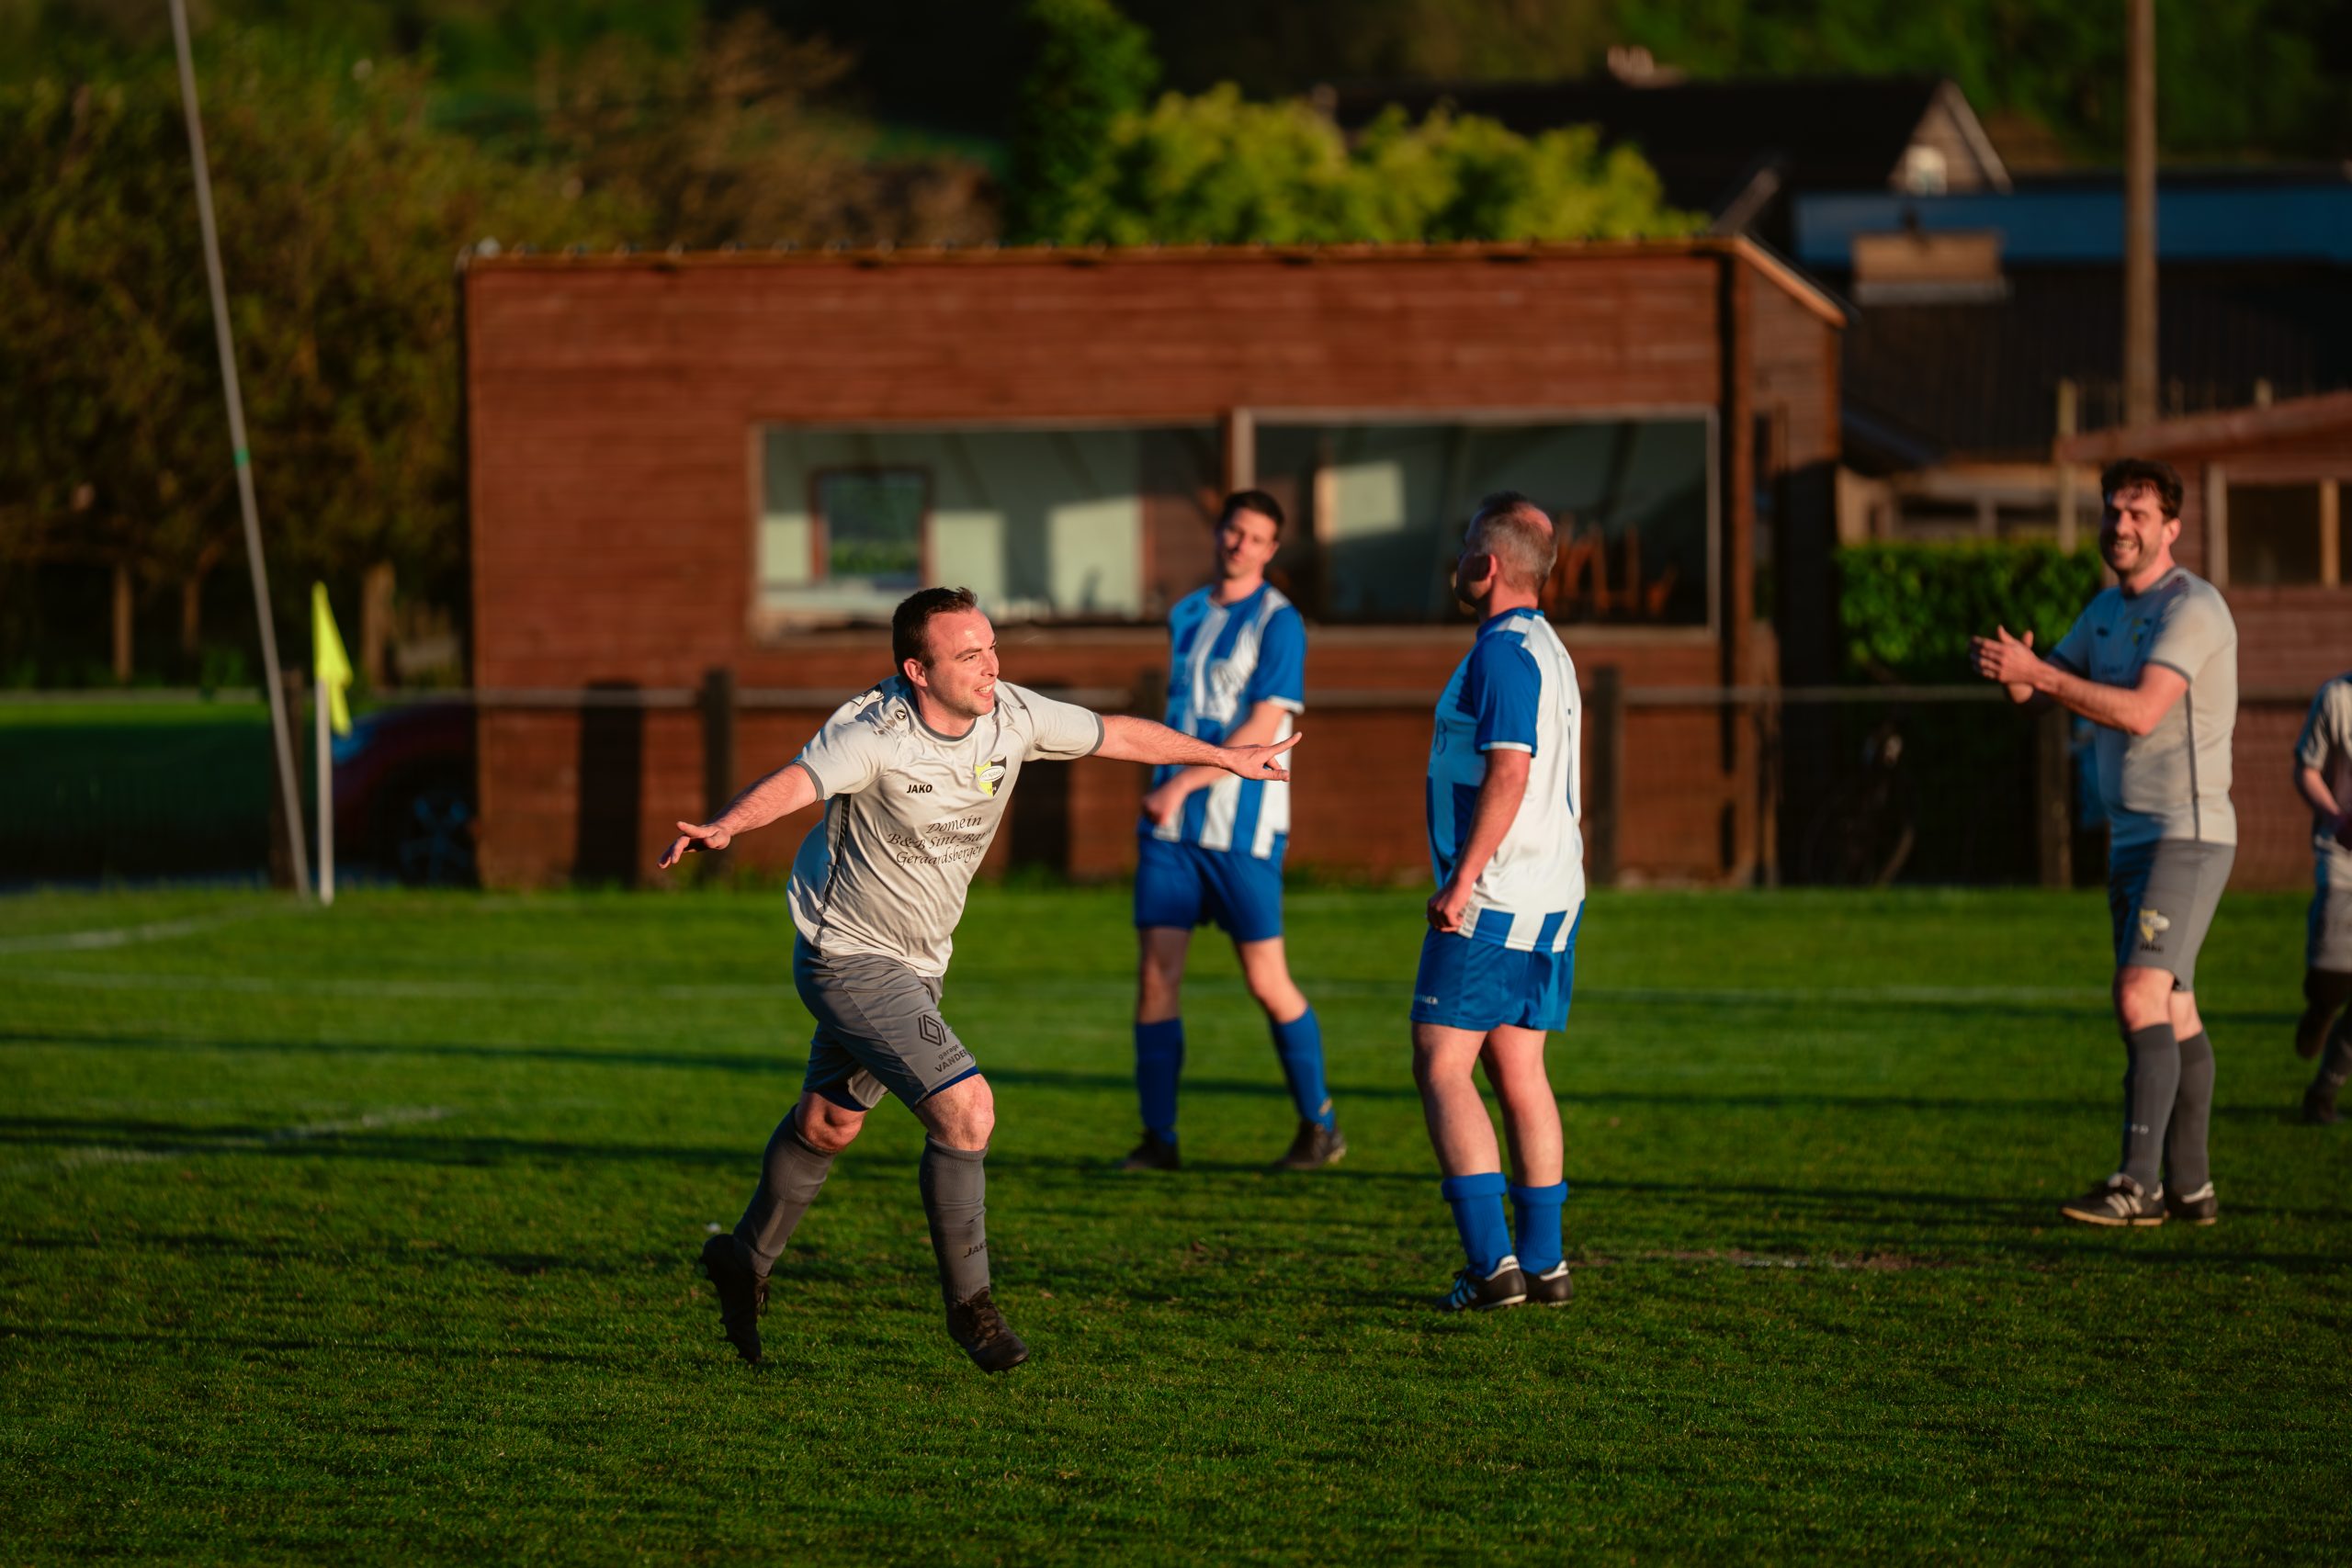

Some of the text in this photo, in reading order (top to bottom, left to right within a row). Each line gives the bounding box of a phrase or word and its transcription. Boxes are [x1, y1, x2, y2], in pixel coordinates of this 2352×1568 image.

[906, 784, 933, 794] JAKO
[926, 815, 982, 834] Domein
[887, 833, 926, 850] B&B
[938, 1043, 959, 1061] garage
